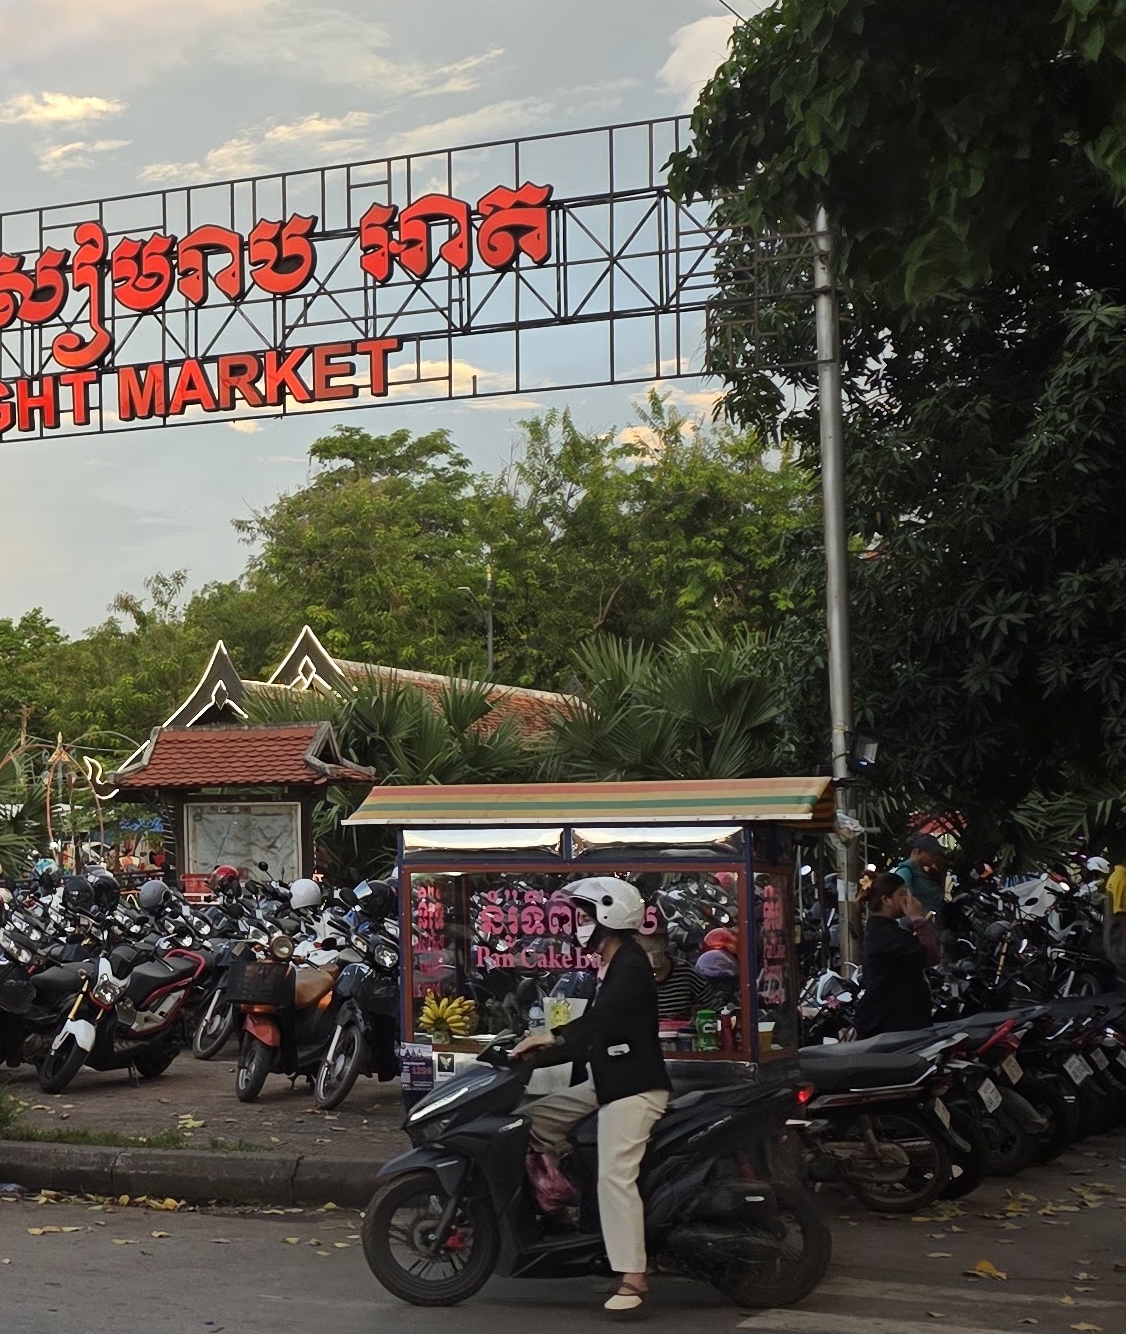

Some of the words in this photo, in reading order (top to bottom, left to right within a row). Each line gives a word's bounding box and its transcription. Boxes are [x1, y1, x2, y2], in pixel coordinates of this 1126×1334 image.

[118, 337, 404, 423] MARKET
[476, 946, 515, 968] Pan
[520, 944, 574, 969] Cake
